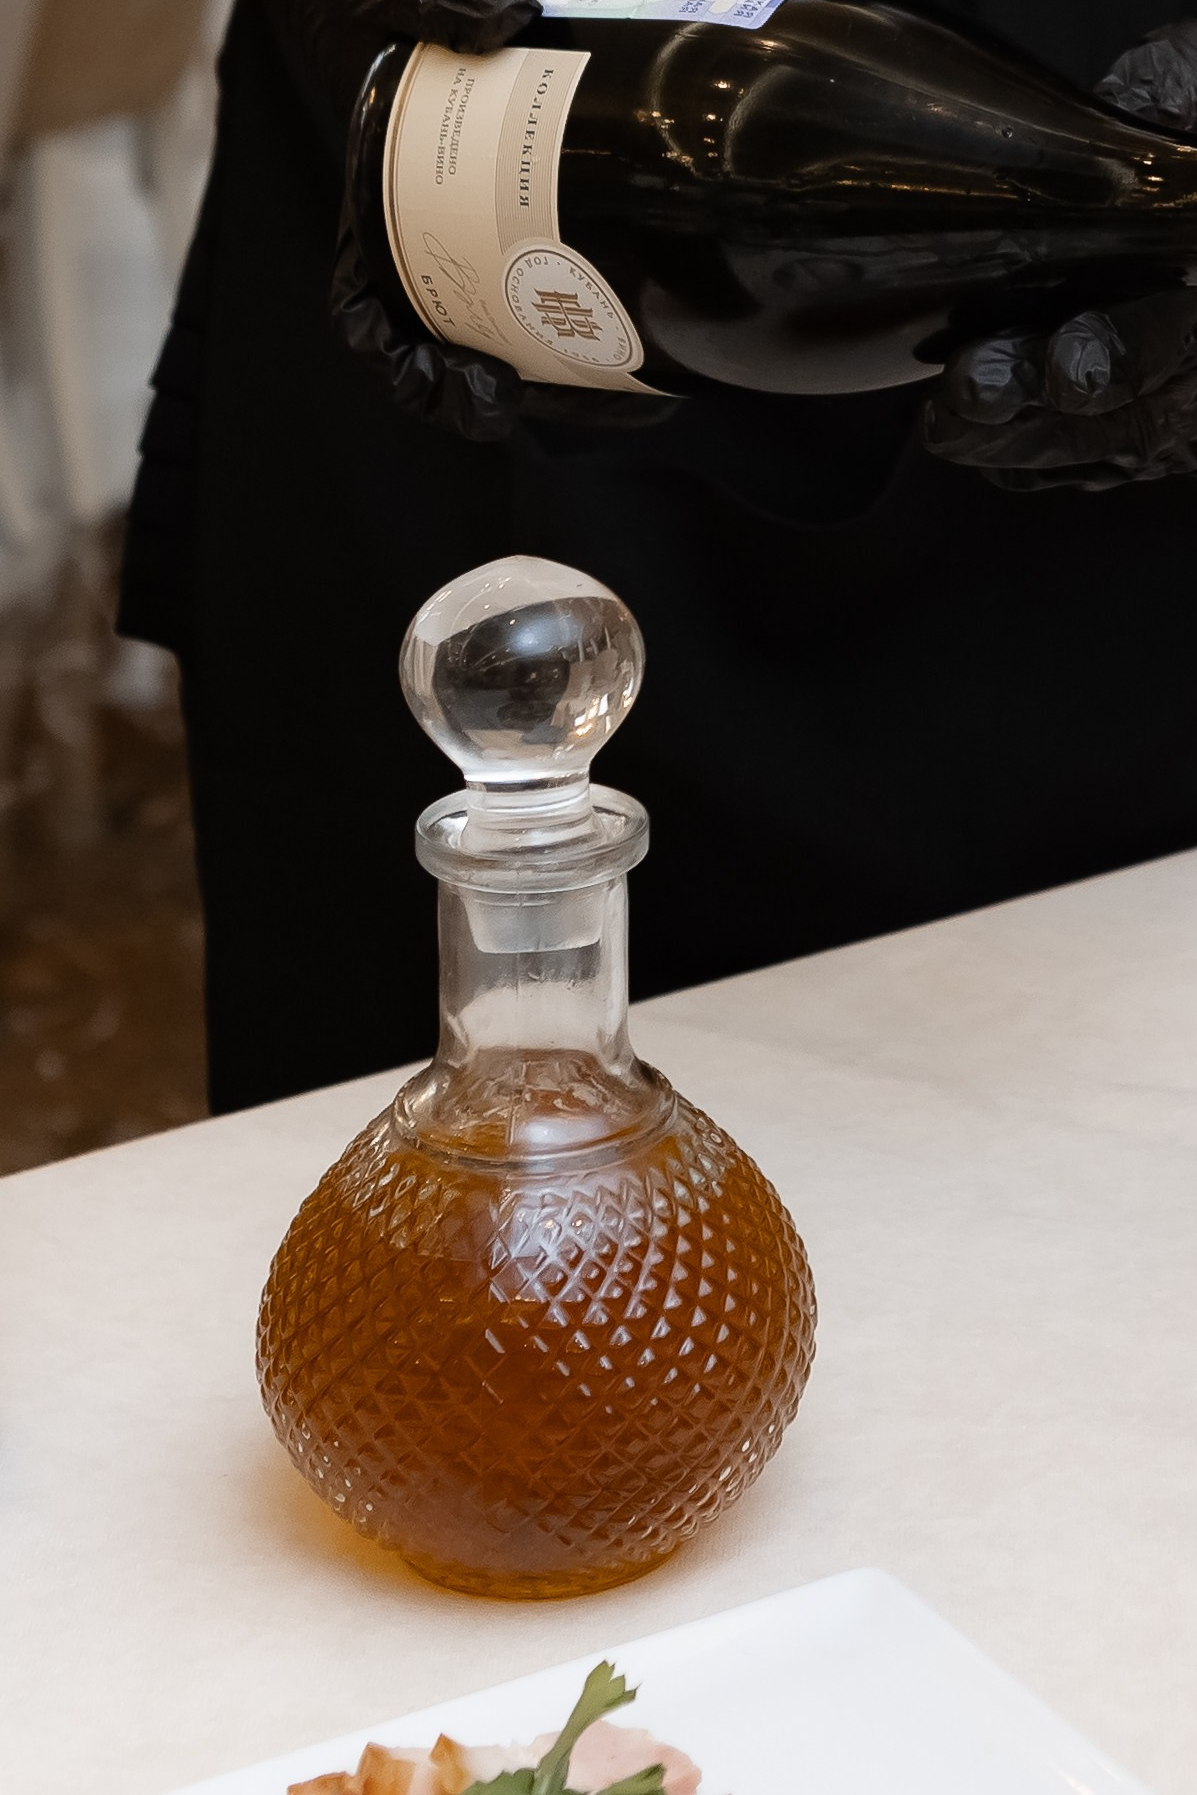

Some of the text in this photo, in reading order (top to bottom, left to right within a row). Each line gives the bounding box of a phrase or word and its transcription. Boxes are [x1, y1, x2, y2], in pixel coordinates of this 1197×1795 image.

[435, 67, 467, 186] НА КУБАНЬ-ВИНО
[448, 77, 475, 176] ПРОИЗВЕДЕНО
[518, 68, 554, 209] КОЛЛЕКЦИЯ
[420, 274, 455, 329] БРЮТ
[524, 256, 549, 269] ГОД
